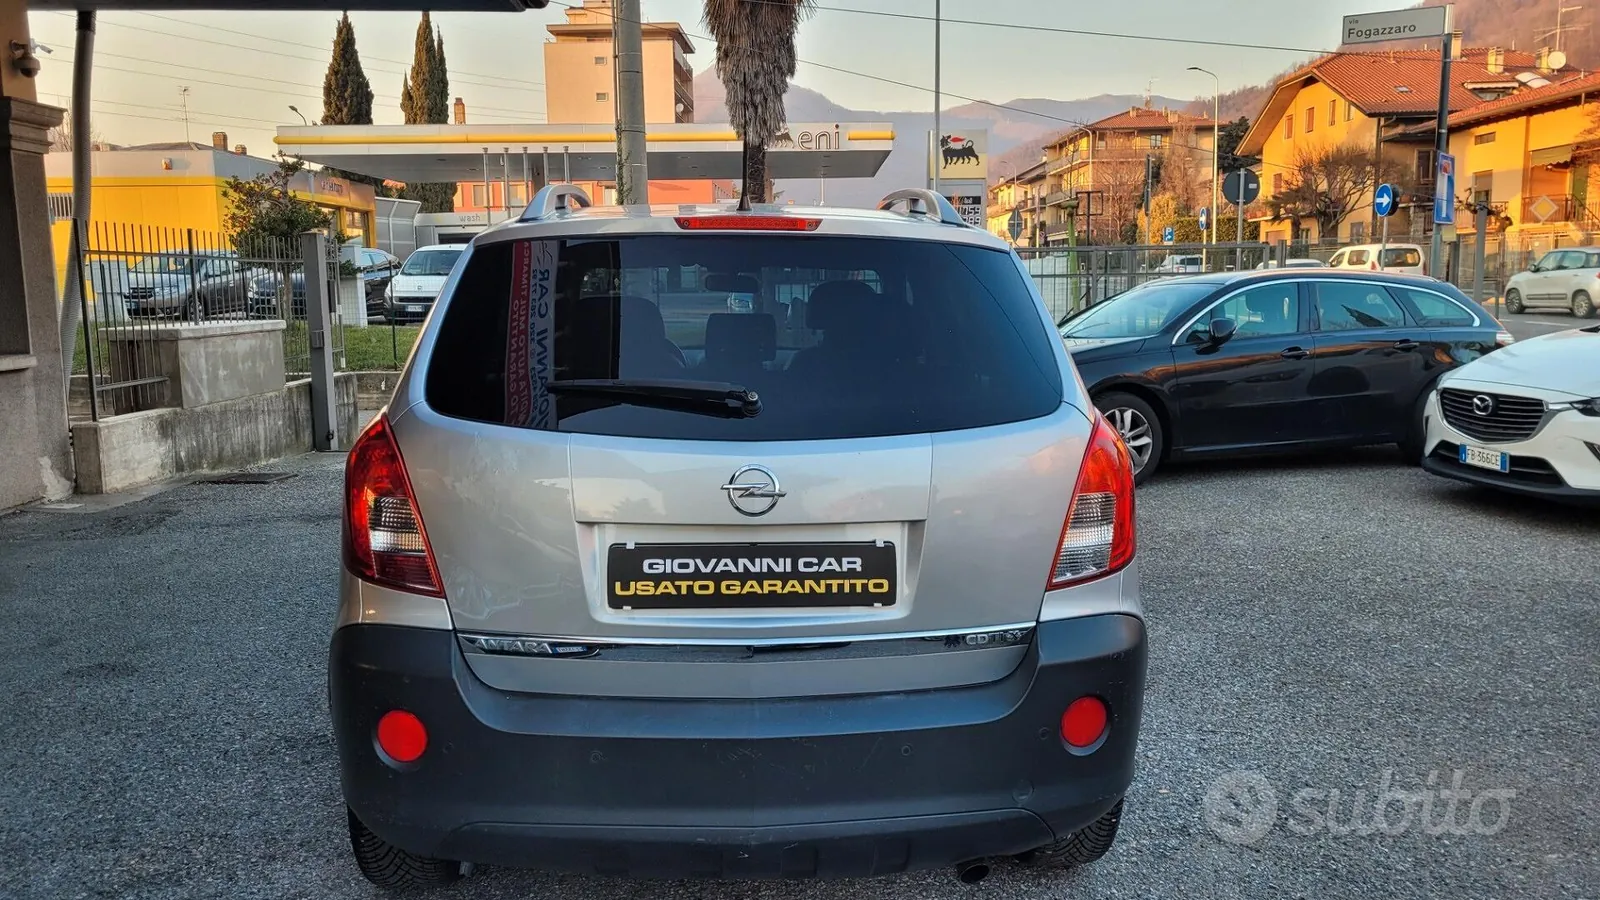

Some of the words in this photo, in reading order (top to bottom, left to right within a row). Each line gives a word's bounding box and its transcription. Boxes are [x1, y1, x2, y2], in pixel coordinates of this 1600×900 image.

[1347, 24, 1417, 39] Fogazzaro
[797, 123, 840, 150] eni
[459, 213, 480, 222] wash
[642, 558, 792, 574] GIOVANNI
[797, 557, 863, 573] CAR
[614, 580, 715, 596] USATO
[720, 578, 889, 595] GARANTITO
[472, 638, 553, 654] ANTARA
